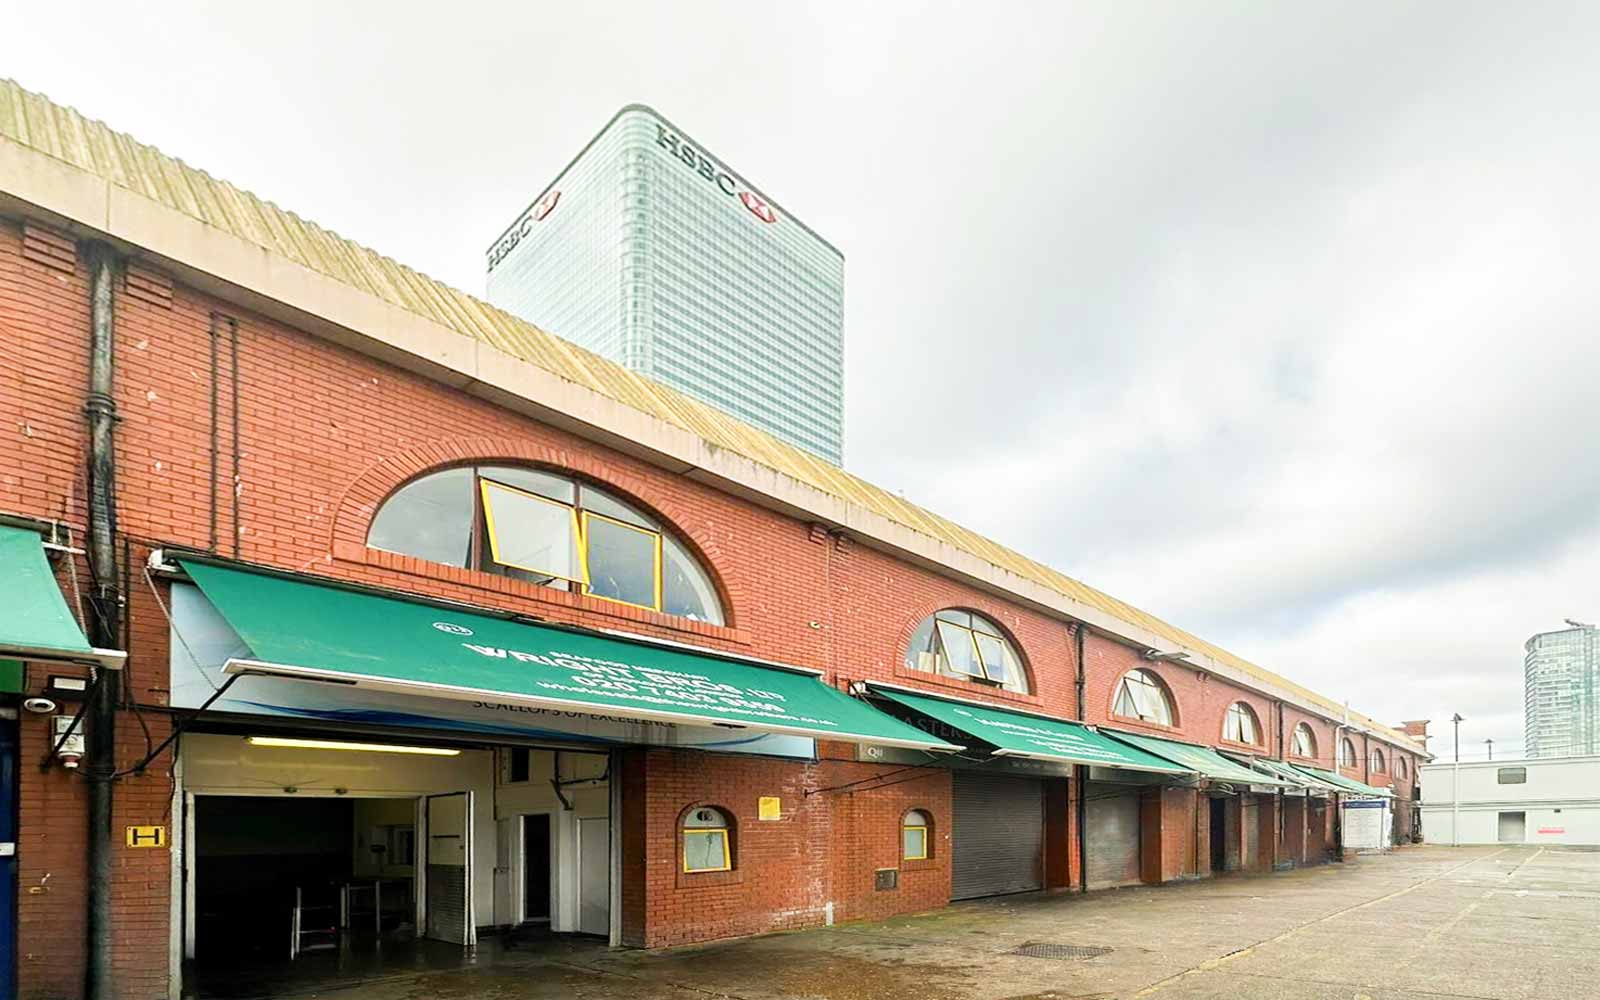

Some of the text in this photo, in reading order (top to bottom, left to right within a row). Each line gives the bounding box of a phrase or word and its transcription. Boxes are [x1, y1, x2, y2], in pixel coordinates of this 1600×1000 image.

[656, 124, 735, 196] HSBC
[487, 215, 532, 273] HSBC
[461, 643, 634, 679] WRIGHT
[571, 675, 638, 692] 020
[133, 828, 159, 845] H
